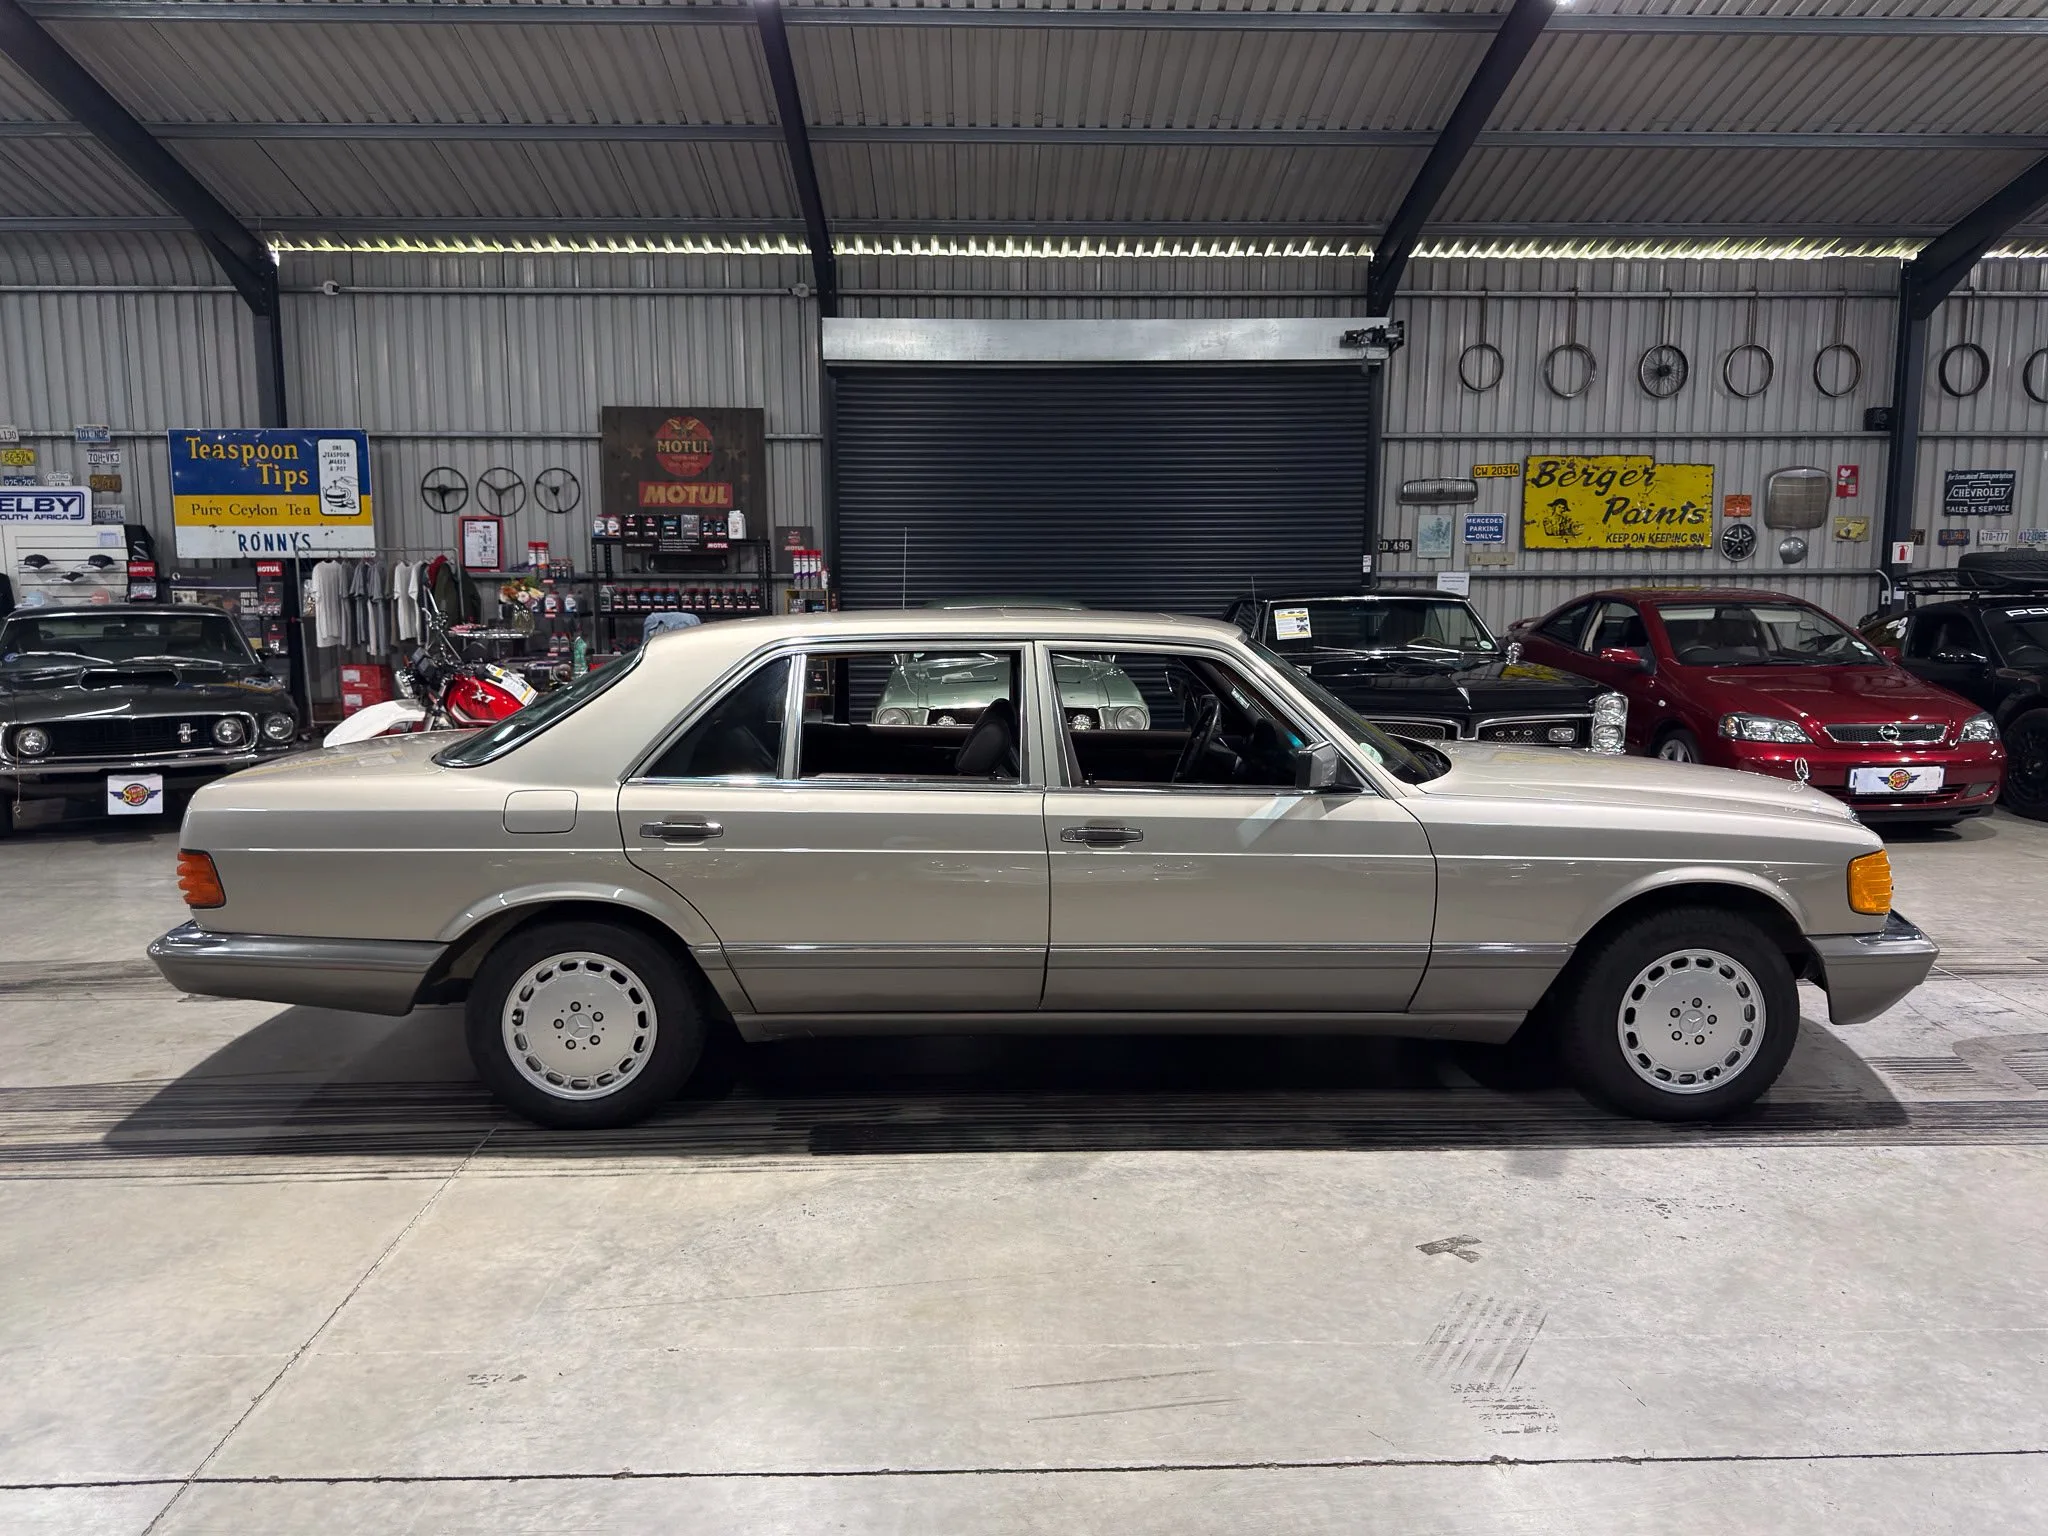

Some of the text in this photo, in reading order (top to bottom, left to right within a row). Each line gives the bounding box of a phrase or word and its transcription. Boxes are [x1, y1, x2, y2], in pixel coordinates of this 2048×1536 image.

[185, 436, 299, 467] Teaspoon
[656, 440, 711, 454] MOTUL
[256, 462, 309, 493] Tips
[1491, 465, 1519, 475] 20314
[1531, 460, 1657, 497] Berger
[643, 485, 730, 505] MOTUL
[1952, 487, 2006, 498] CHEVROLET
[191, 502, 312, 518] Pure Ceylon Tea
[1601, 496, 1708, 526] Paints
[1978, 504, 2010, 513] SERVICE
[238, 532, 312, 552] RONNYS
[1605, 533, 1705, 543] KEEP ON KEEPING ON
[1495, 729, 1534, 738] GTO
